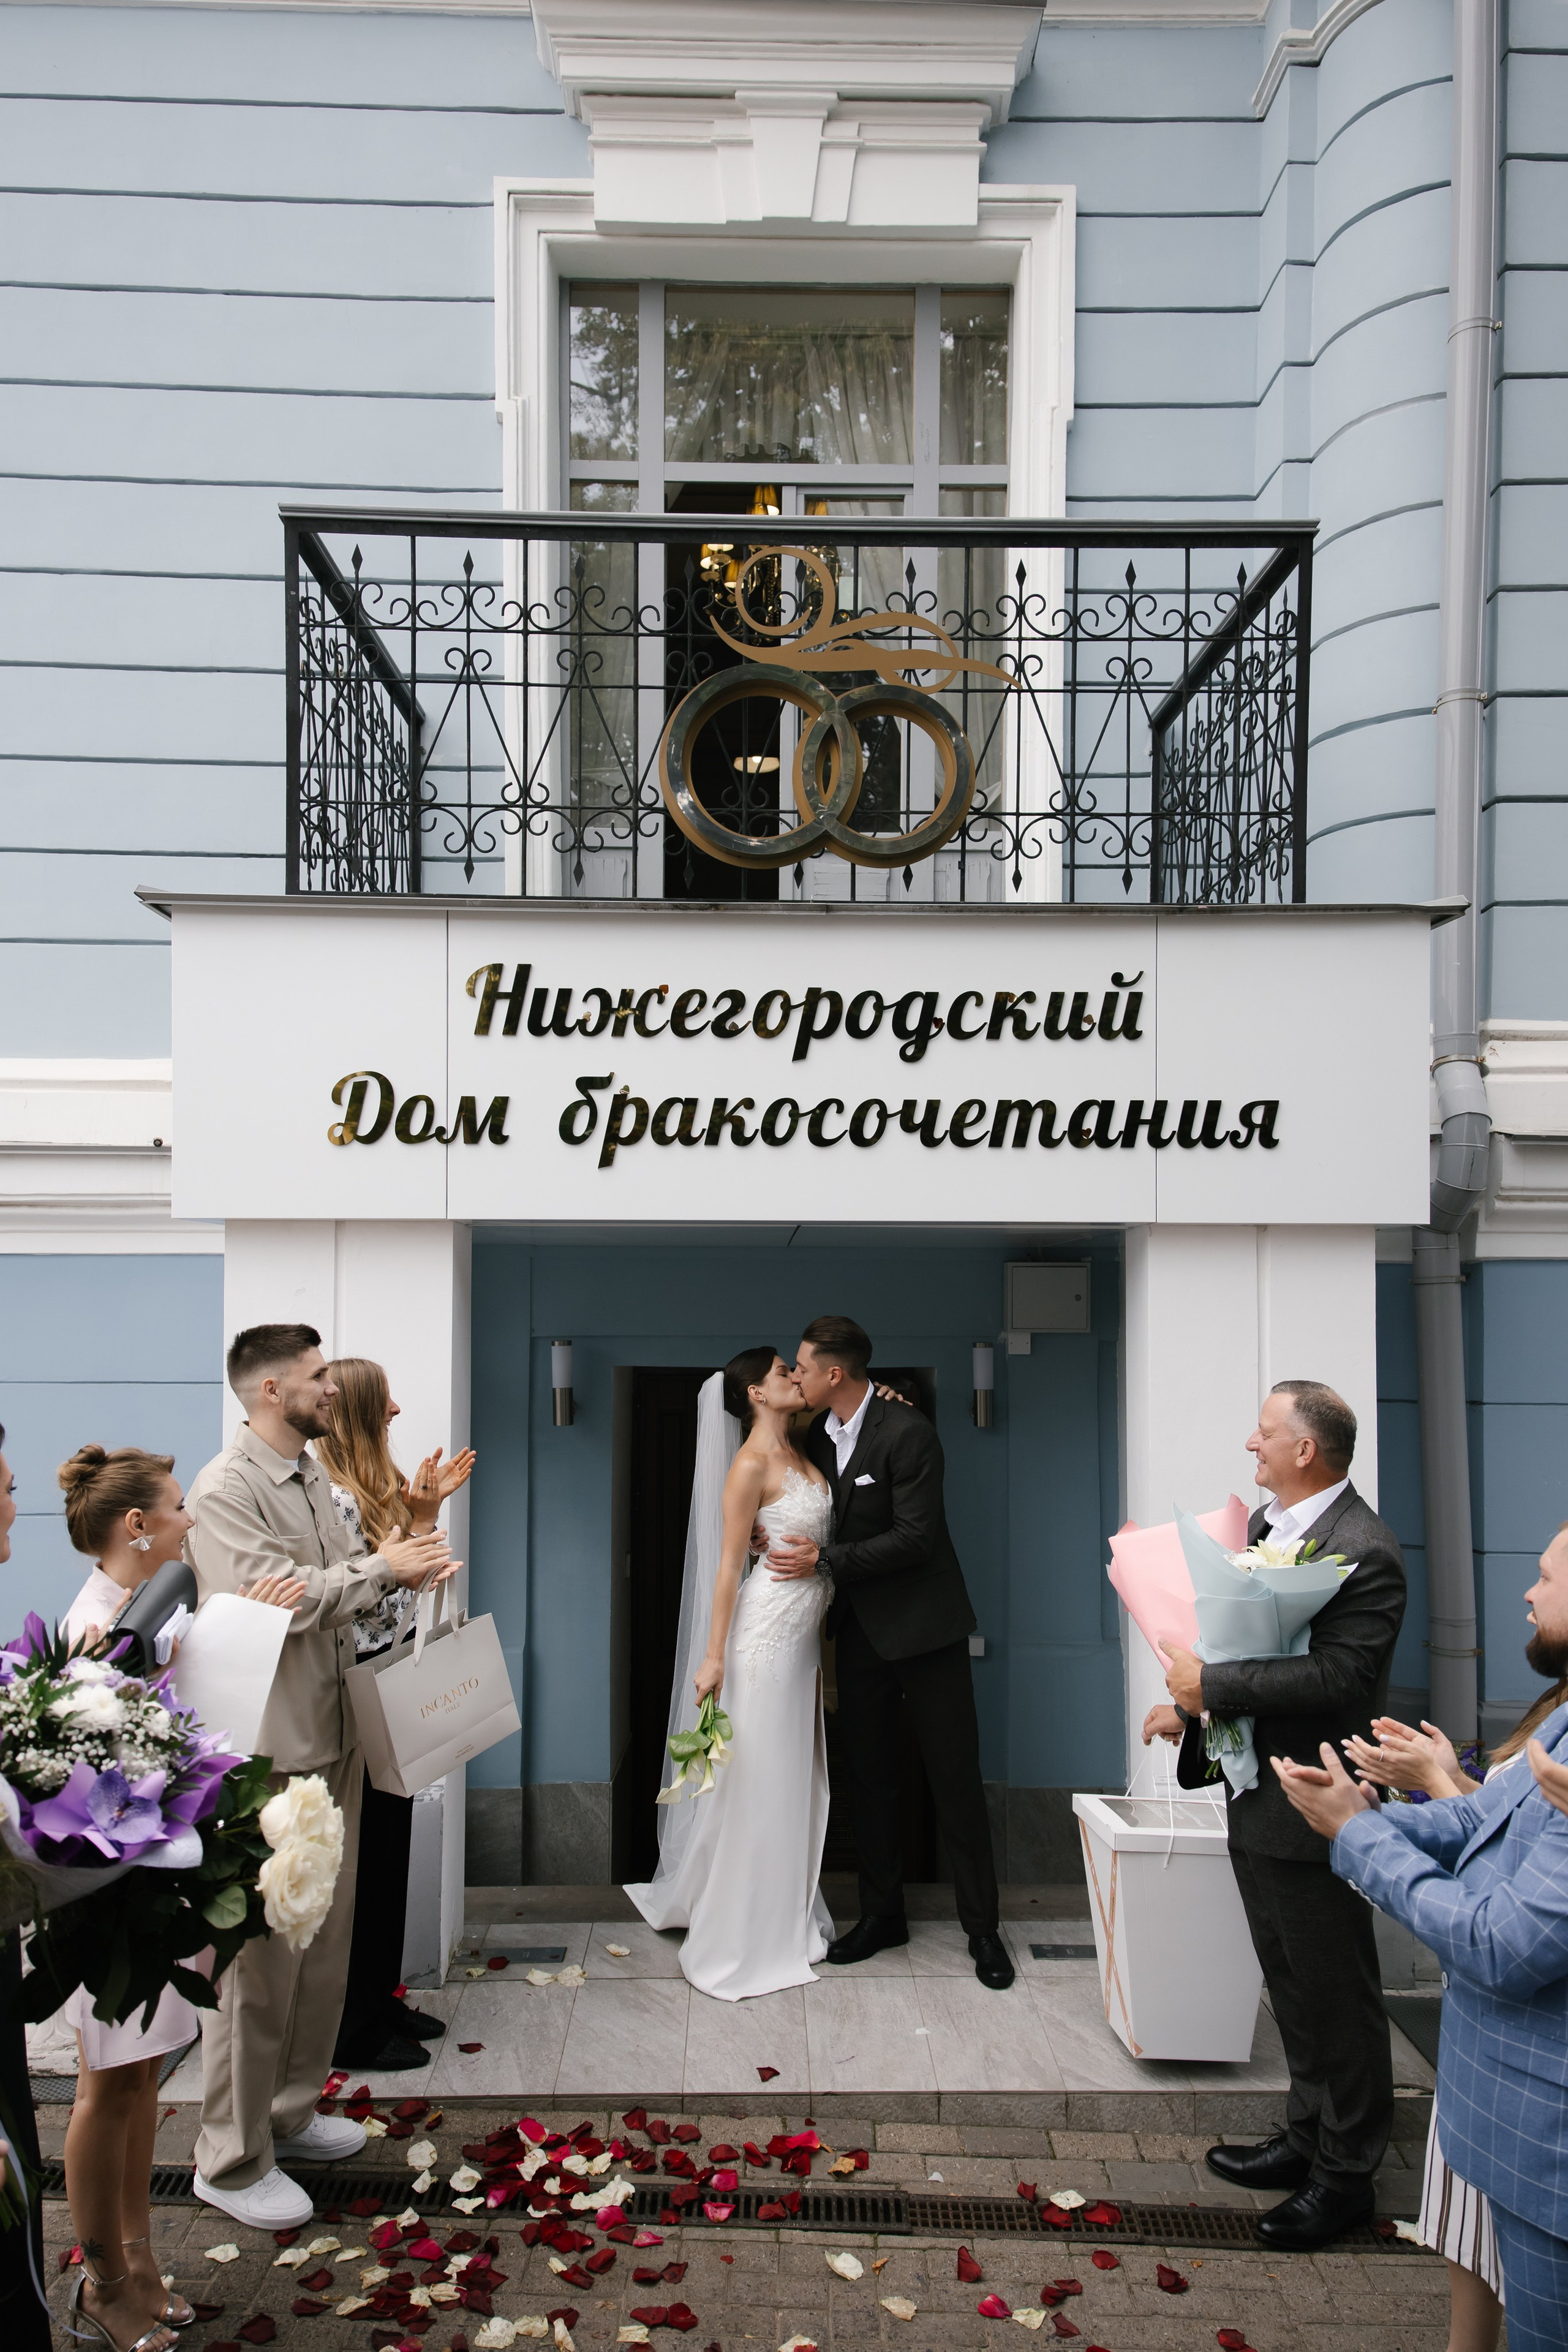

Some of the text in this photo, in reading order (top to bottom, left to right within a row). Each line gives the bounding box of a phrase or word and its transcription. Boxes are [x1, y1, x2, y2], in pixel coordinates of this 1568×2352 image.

[466, 962, 1145, 1063] Нижегородский
[327, 1071, 1280, 1169] Дом бракосочетания
[420, 1676, 478, 1719] INCANTO
[445, 1702, 460, 1714] ITALY
